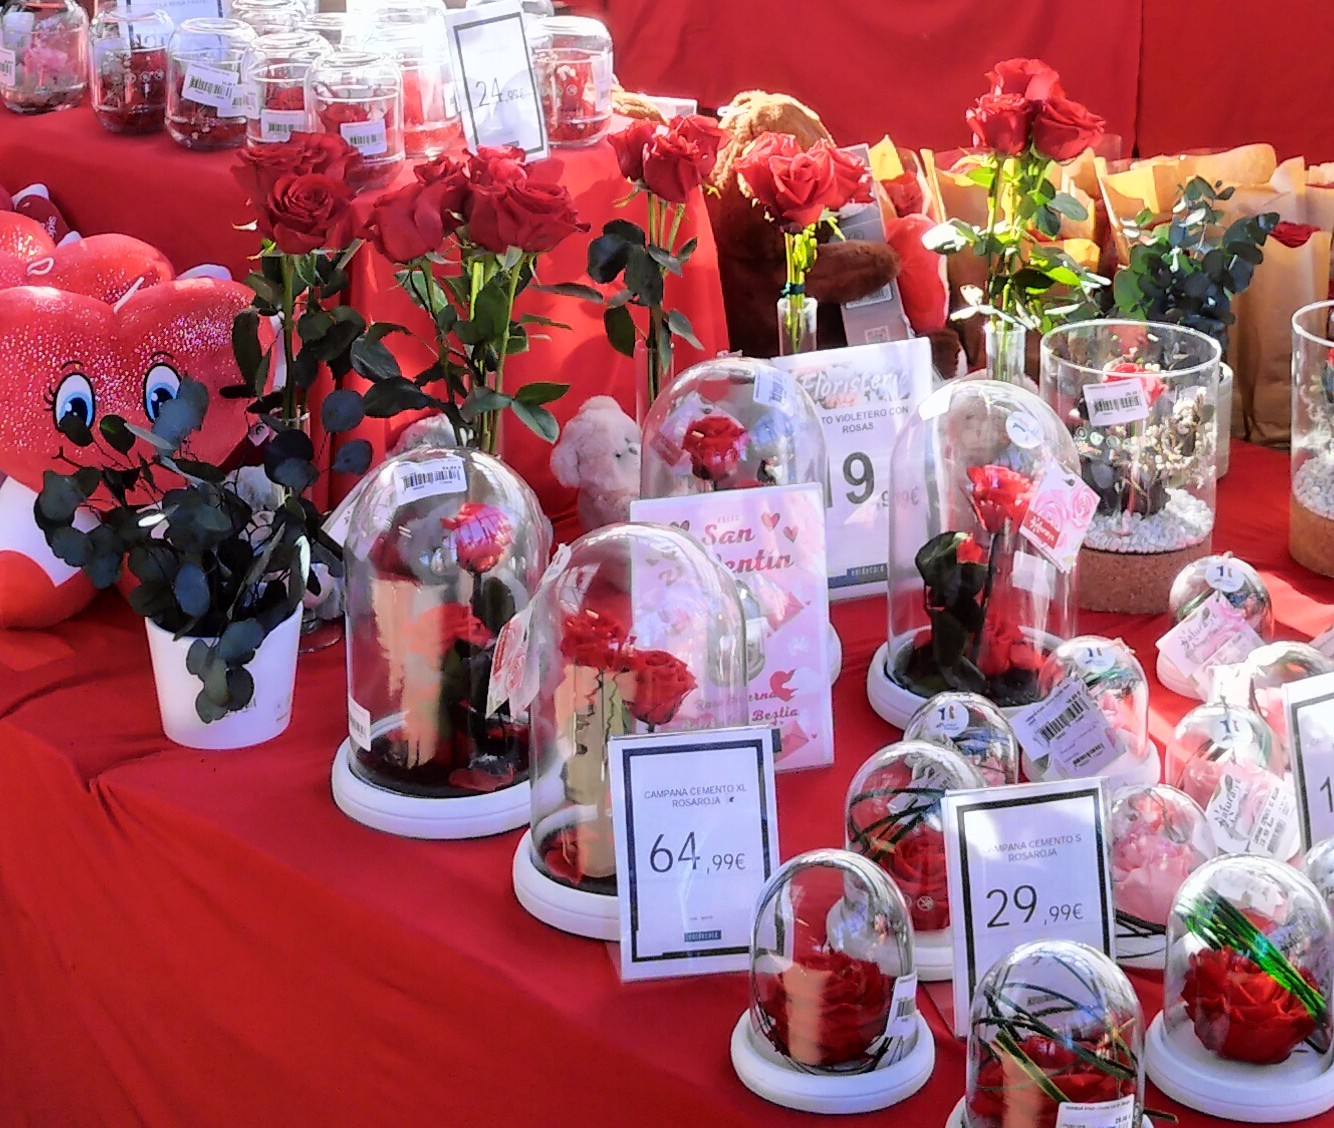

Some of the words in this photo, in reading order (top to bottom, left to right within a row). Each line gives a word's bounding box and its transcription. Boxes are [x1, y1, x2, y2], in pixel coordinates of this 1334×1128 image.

[835, 409, 887, 423] VIOLETERO
[889, 406, 909, 416] CON
[842, 422, 874, 433] ROSAS
[701, 524, 756, 546] San
[717, 549, 795, 574] entín
[644, 788, 688, 799] CAMPANA
[690, 785, 734, 796] CEMENTO
[736, 783, 747, 792] XL
[672, 797, 721, 808] ROSAROJA
[1028, 836, 1073, 848] CEMENTO
[1075, 834, 1082, 842] S
[650, 831, 746, 874] 64,99€
[1008, 848, 1058, 862] ROSAROJA
[986, 885, 1083, 928] 29,99€
